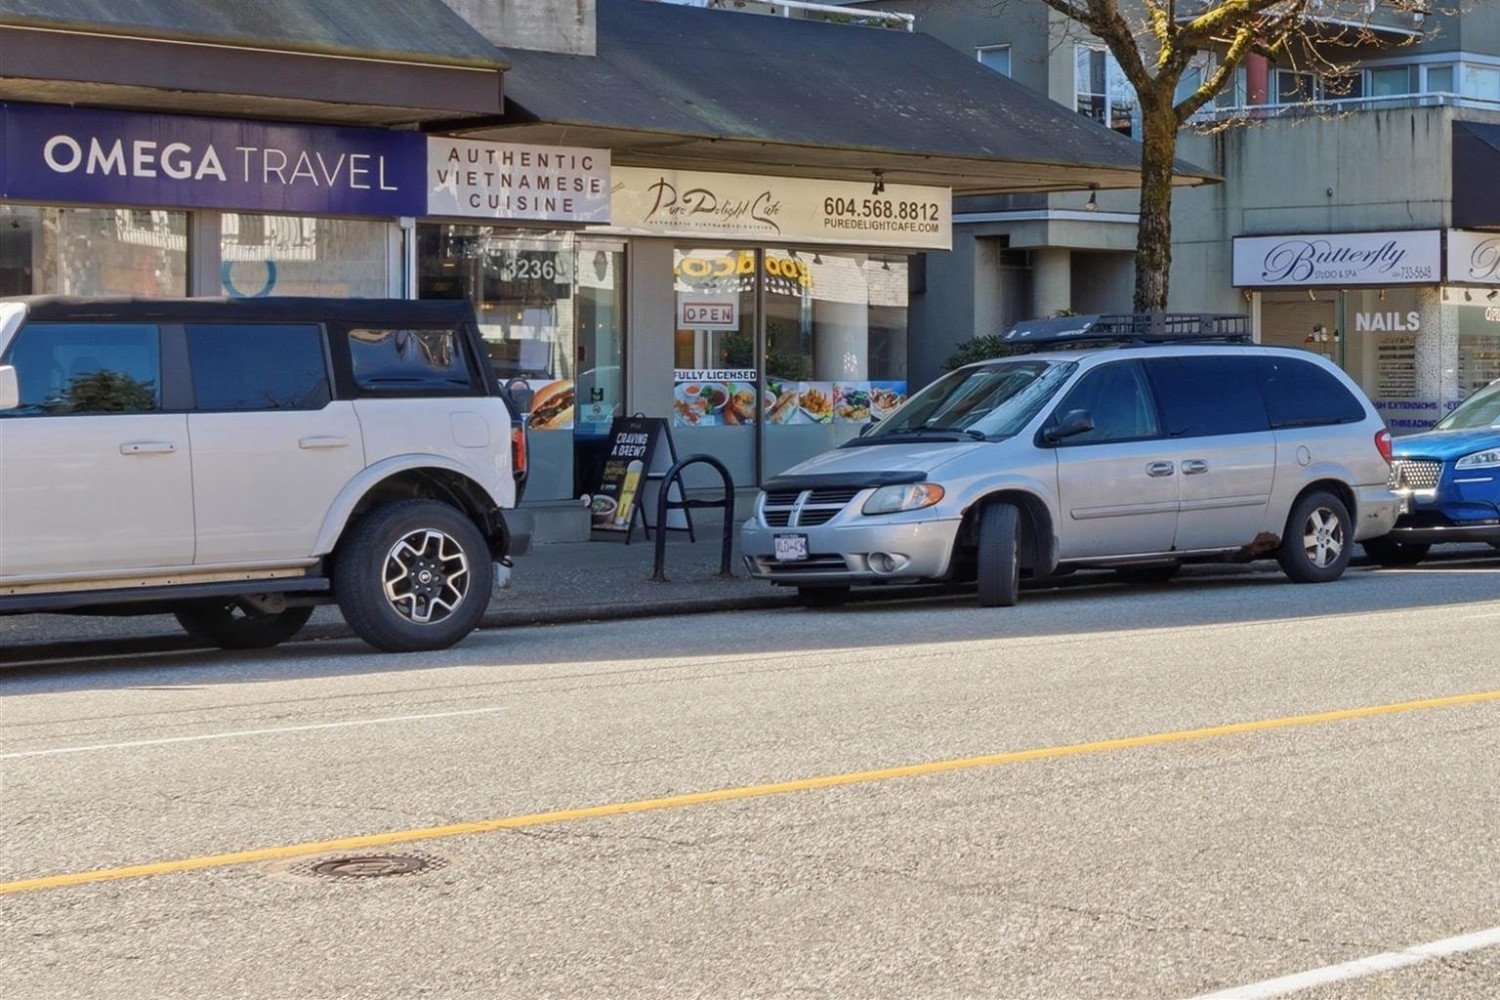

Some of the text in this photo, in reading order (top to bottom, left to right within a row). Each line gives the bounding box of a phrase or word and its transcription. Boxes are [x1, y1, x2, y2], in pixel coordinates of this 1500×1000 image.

[43, 135, 398, 191] OMEGA TRAVEL
[448, 147, 593, 170] AUTHENTIC
[437, 170, 600, 193] VIETNAMESE
[469, 194, 573, 212] CUISINE
[644, 177, 782, 235] Pure Delight Café
[824, 197, 939, 221] 604.568.8812
[824, 218, 939, 232] PUREDELIGHTCAFE.COM
[507, 260, 555, 280] 3236
[1261, 239, 1406, 282] Butterfly
[687, 308, 731, 321] OPEN
[1355, 311, 1420, 331] NAILS
[674, 370, 757, 380] FULLY LICENSED
[616, 433, 649, 444] CRAVING
[611, 446, 619, 456] A
